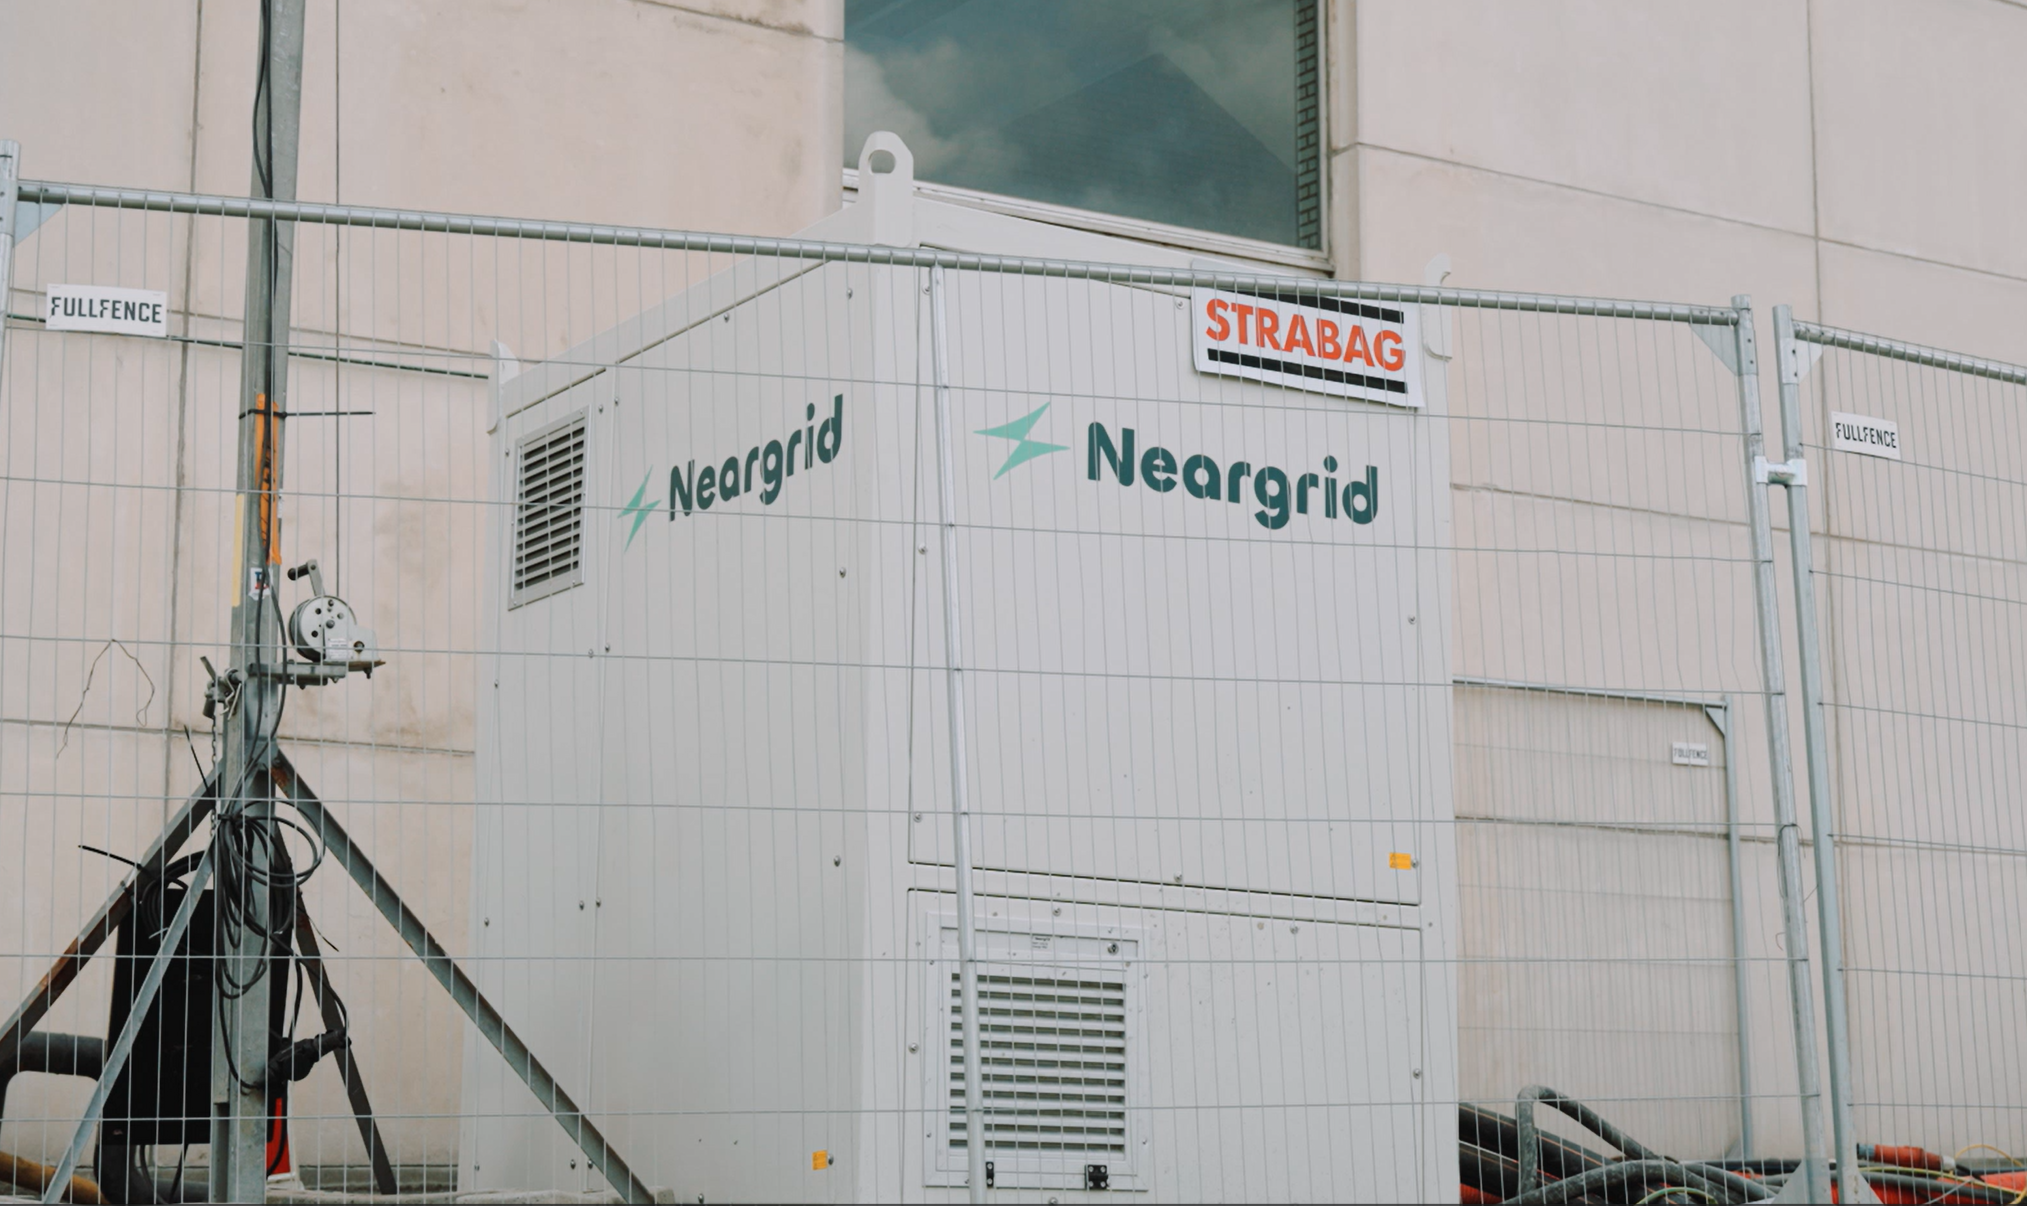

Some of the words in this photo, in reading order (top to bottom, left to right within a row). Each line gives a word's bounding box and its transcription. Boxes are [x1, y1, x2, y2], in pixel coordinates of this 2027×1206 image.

[50, 296, 162, 324] FULLFENCE
[1206, 298, 1407, 372] STRABAG
[669, 393, 843, 522] Neargrid
[1835, 421, 1897, 449] FULLFENCE
[1088, 421, 1379, 530] Neargrid
